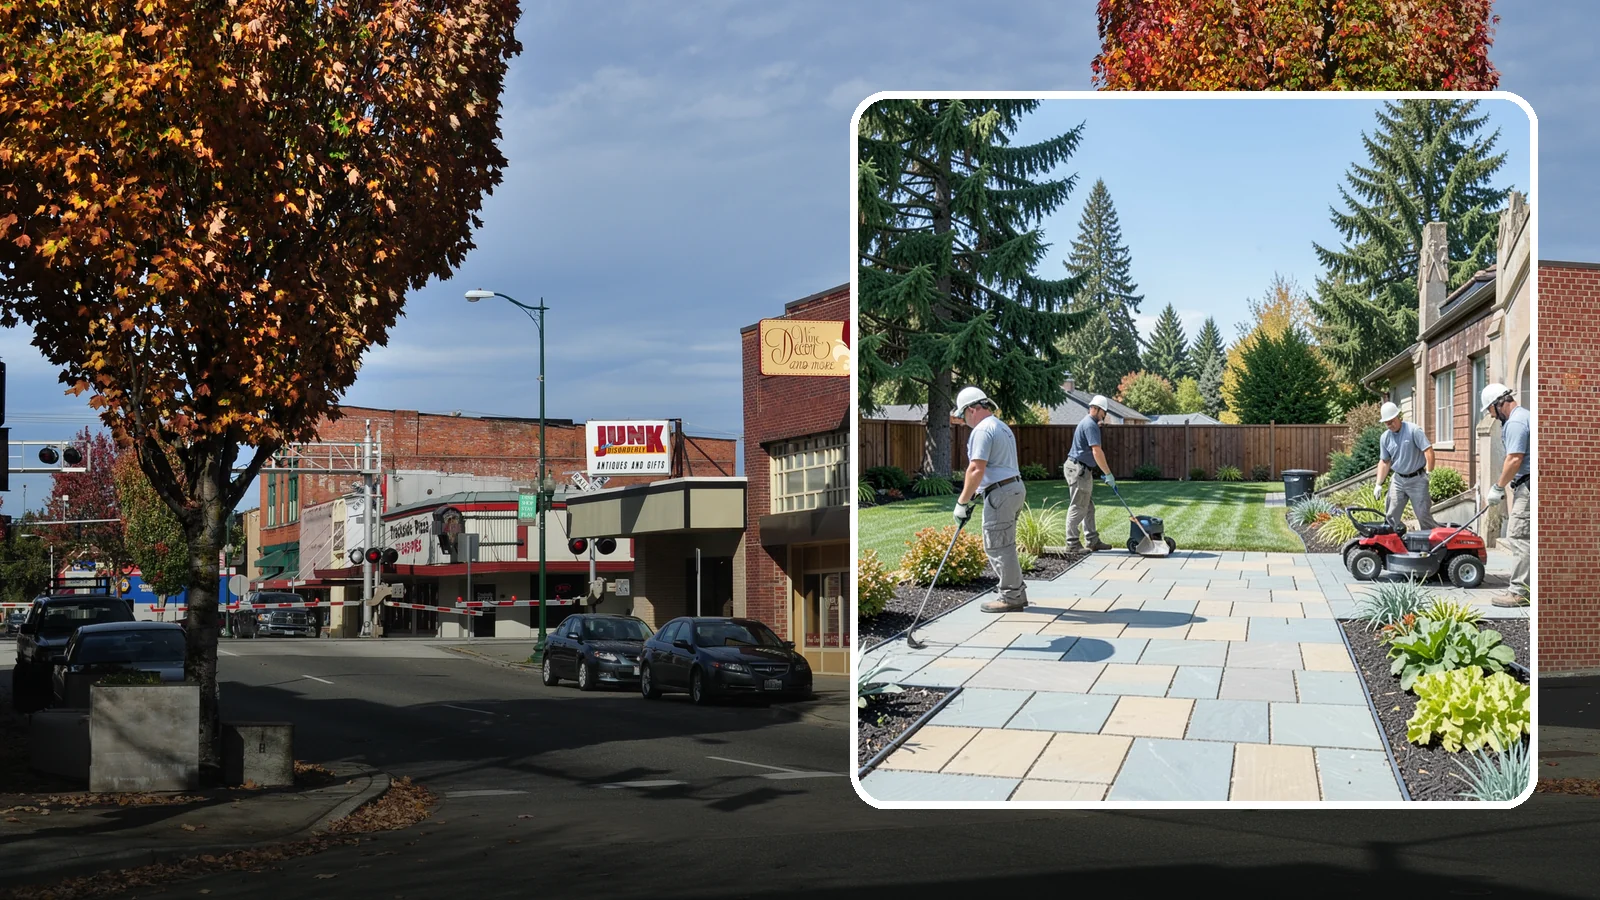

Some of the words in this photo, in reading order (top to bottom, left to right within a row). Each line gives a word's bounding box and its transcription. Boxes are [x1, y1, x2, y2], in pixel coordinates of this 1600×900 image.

[595, 425, 665, 457] JUNK
[607, 446, 645, 454] DISORDERLY
[597, 461, 628, 470] ANTIQUES
[631, 461, 644, 470] AND
[647, 460, 665, 470] GIFTS
[573, 473, 589, 491] RAIL
[353, 498, 364, 511] CRO
[414, 519, 429, 534] Pizza
